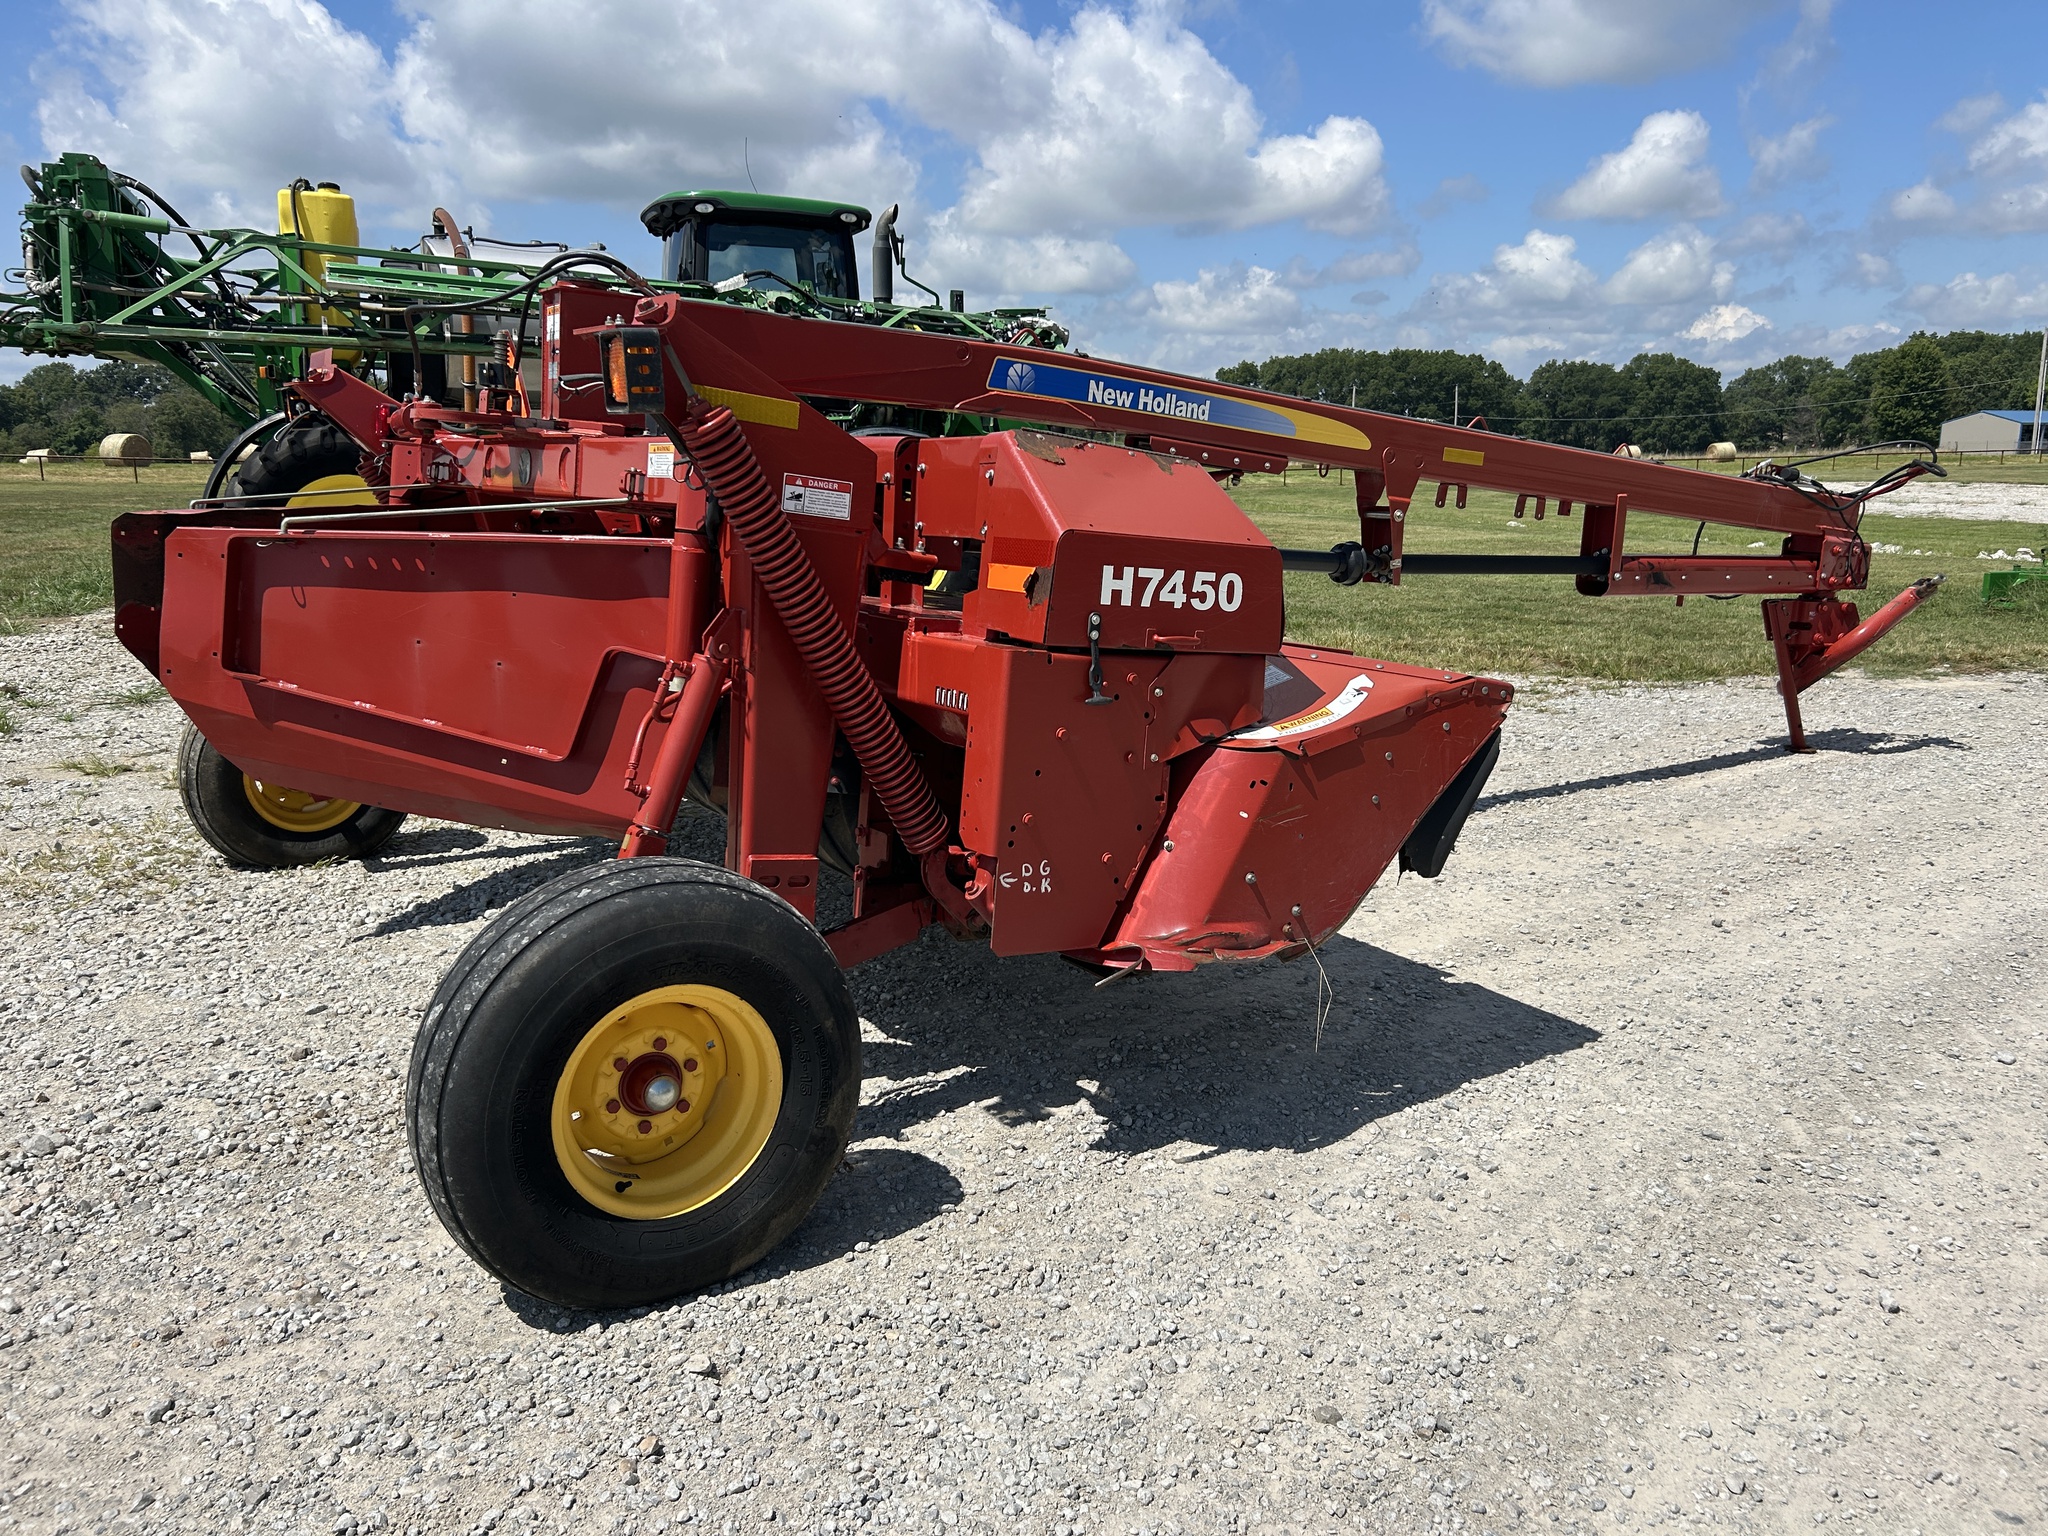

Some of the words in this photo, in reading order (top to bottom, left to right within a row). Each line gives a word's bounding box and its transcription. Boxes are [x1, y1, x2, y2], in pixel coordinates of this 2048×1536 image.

[1088, 379, 1134, 408] New
[1138, 388, 1211, 421] Holland
[808, 479, 839, 490] DANGER
[1100, 565, 1243, 613] H7450
[1289, 710, 1329, 728] WARNING
[649, 959, 752, 982] TRACK
[664, 1169, 780, 1251] AKURET
